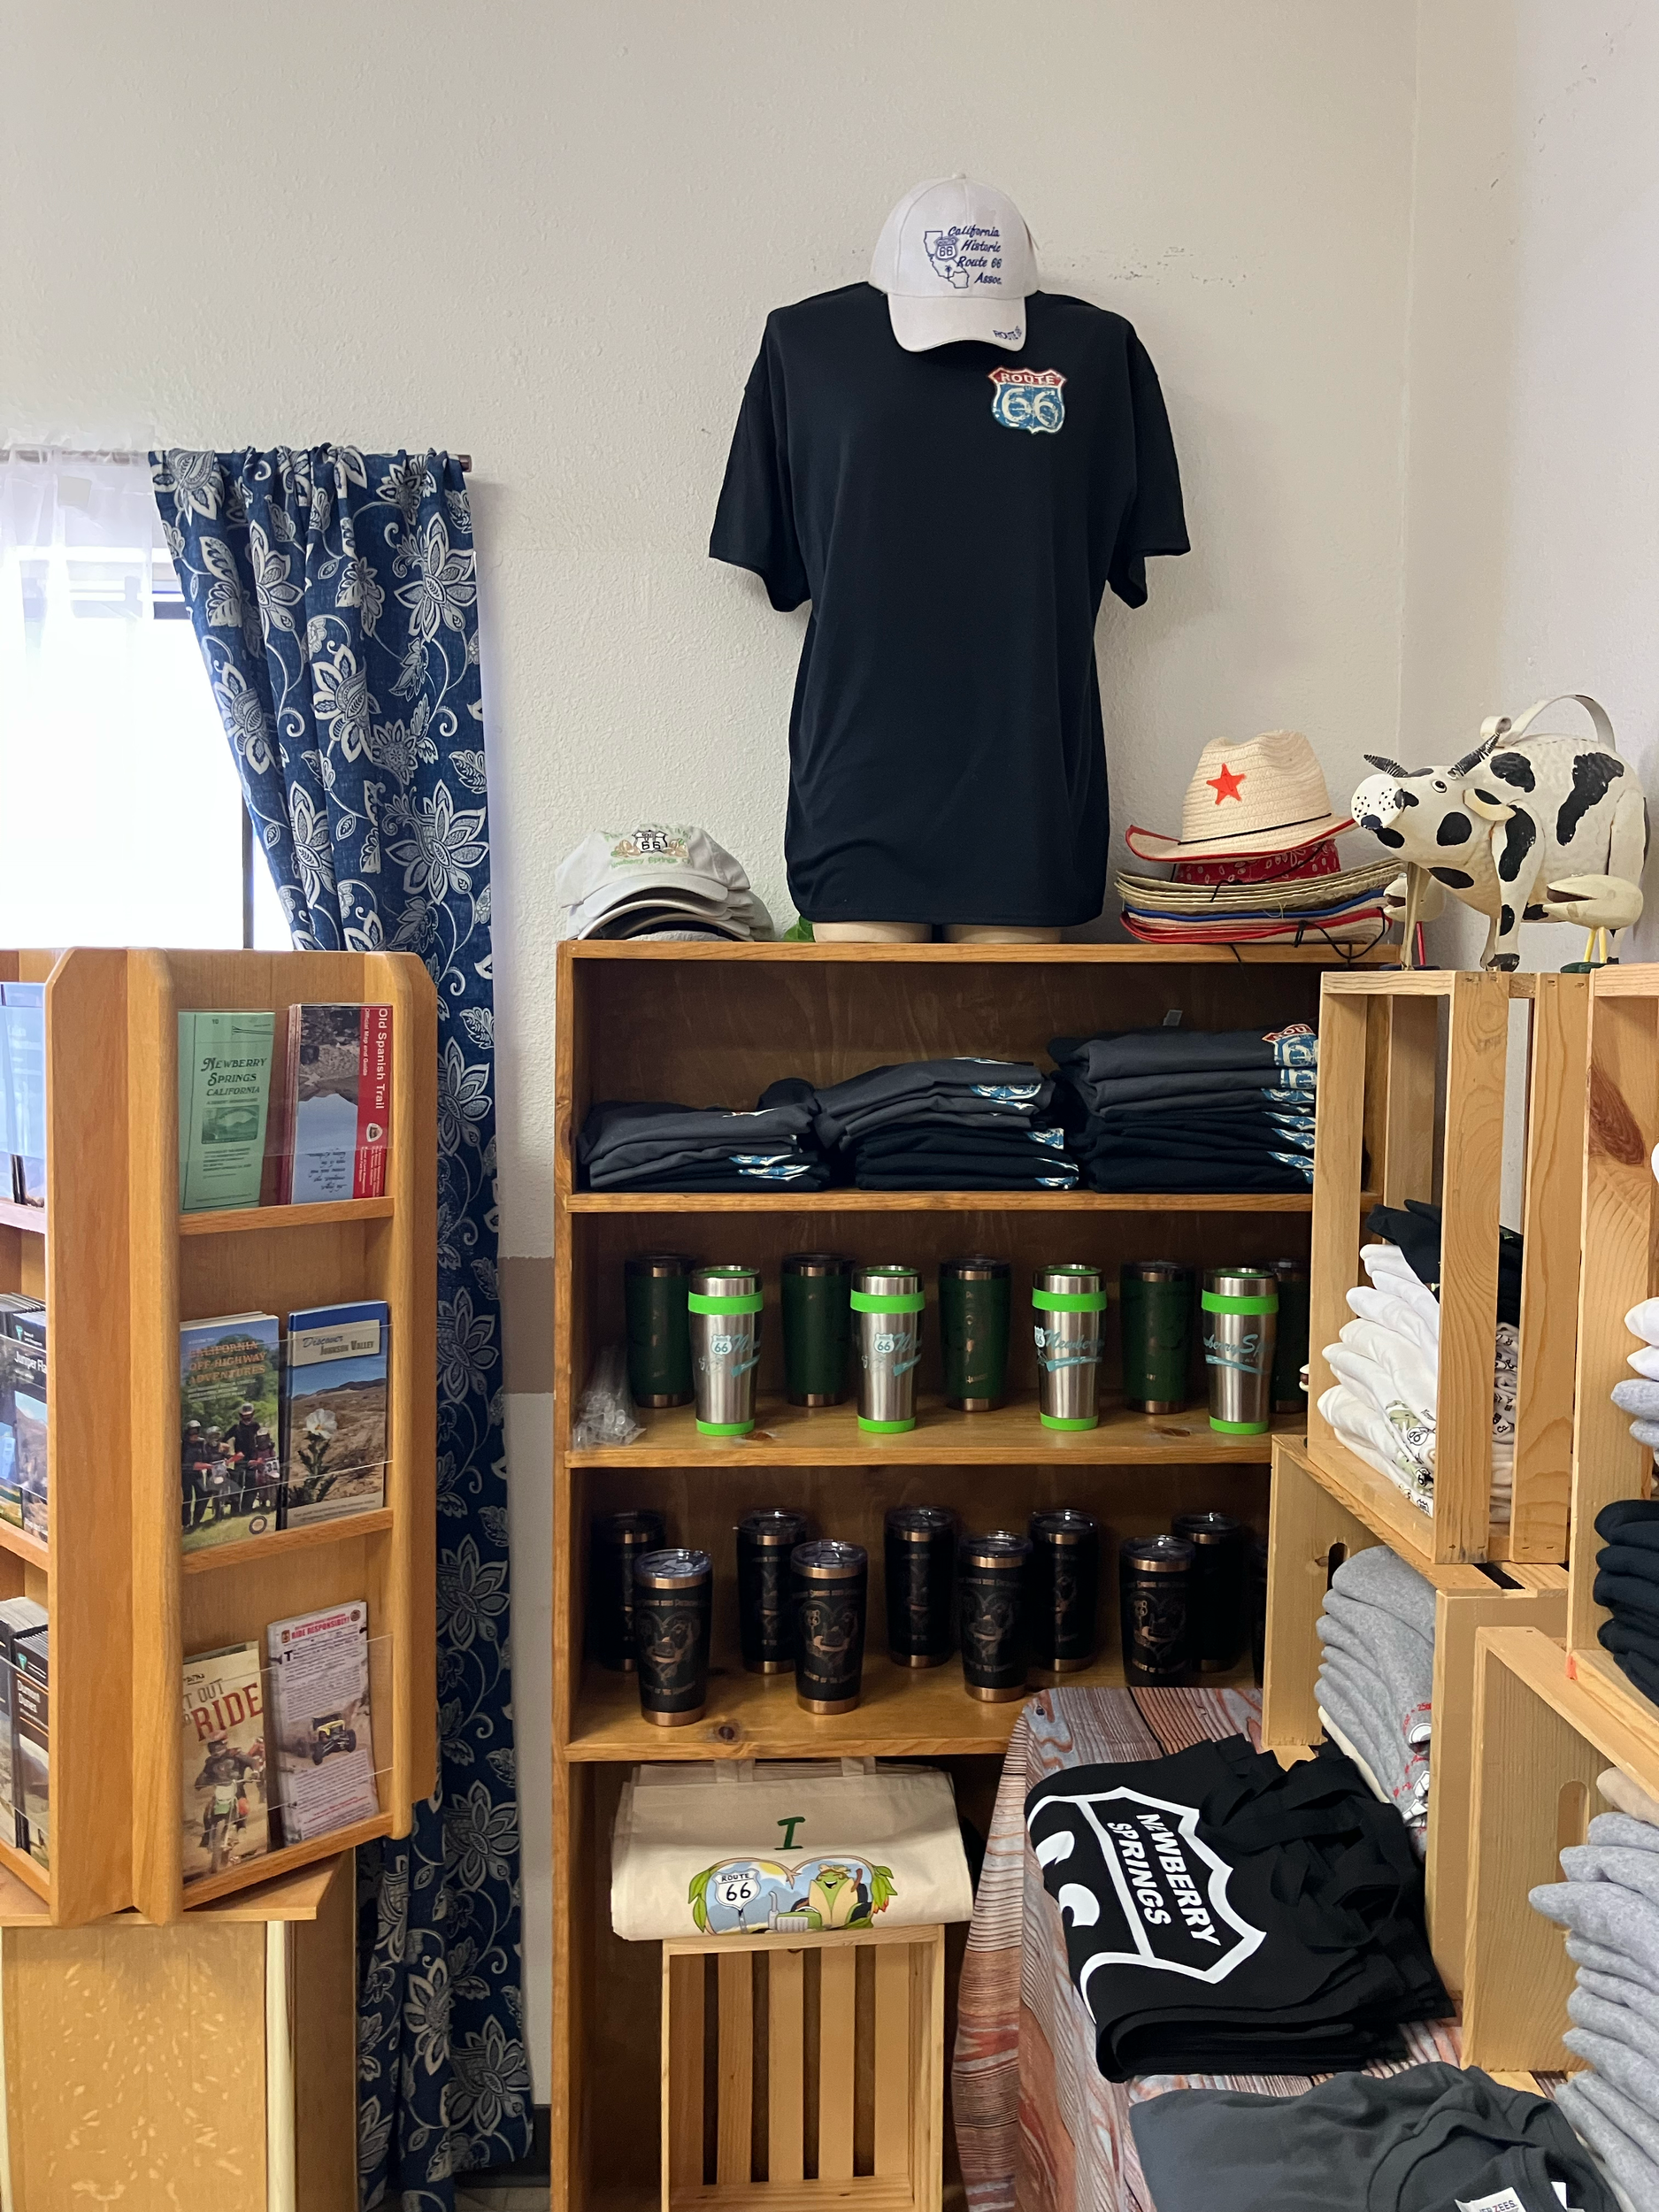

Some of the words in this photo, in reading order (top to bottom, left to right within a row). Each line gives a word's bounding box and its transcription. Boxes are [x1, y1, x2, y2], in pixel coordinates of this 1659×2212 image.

[948, 225, 1001, 238] California
[939, 246, 953, 257] 66
[961, 240, 1001, 252] Historic
[956, 256, 988, 267] Route
[991, 257, 1002, 268] 66
[1000, 373, 1056, 385] ROUTE
[1002, 388, 1059, 428] 66
[641, 841, 661, 850] 66
[378, 1008, 388, 1029] Old
[201, 1057, 267, 1071] NEWBERRY
[376, 1033, 388, 1080] Spanish
[207, 1072, 257, 1087] SPRINGS
[206, 1087, 260, 1096] CALIFORNIA
[375, 1084, 386, 1110] Trail
[189, 1341, 258, 1357] CALIFORNIA
[303, 1335, 343, 1348] Discover
[350, 1340, 374, 1351] VALLEY
[715, 1342, 728, 1353] 66
[877, 1340, 891, 1351] 66
[37, 1358, 48, 1375] Fla
[189, 1352, 267, 1371] OFF-HIGHWAY
[190, 1365, 265, 1385] ADVENTURES
[197, 1678, 224, 1703] OUT
[191, 1682, 264, 1742] RIDE
[774, 1816, 806, 1850] I
[721, 1872, 749, 1882] ROUTE
[1107, 1822, 1172, 1924] SPRINGS
[1136, 1814, 1222, 1946] NEWBERRY
[726, 1882, 751, 1901] 66
